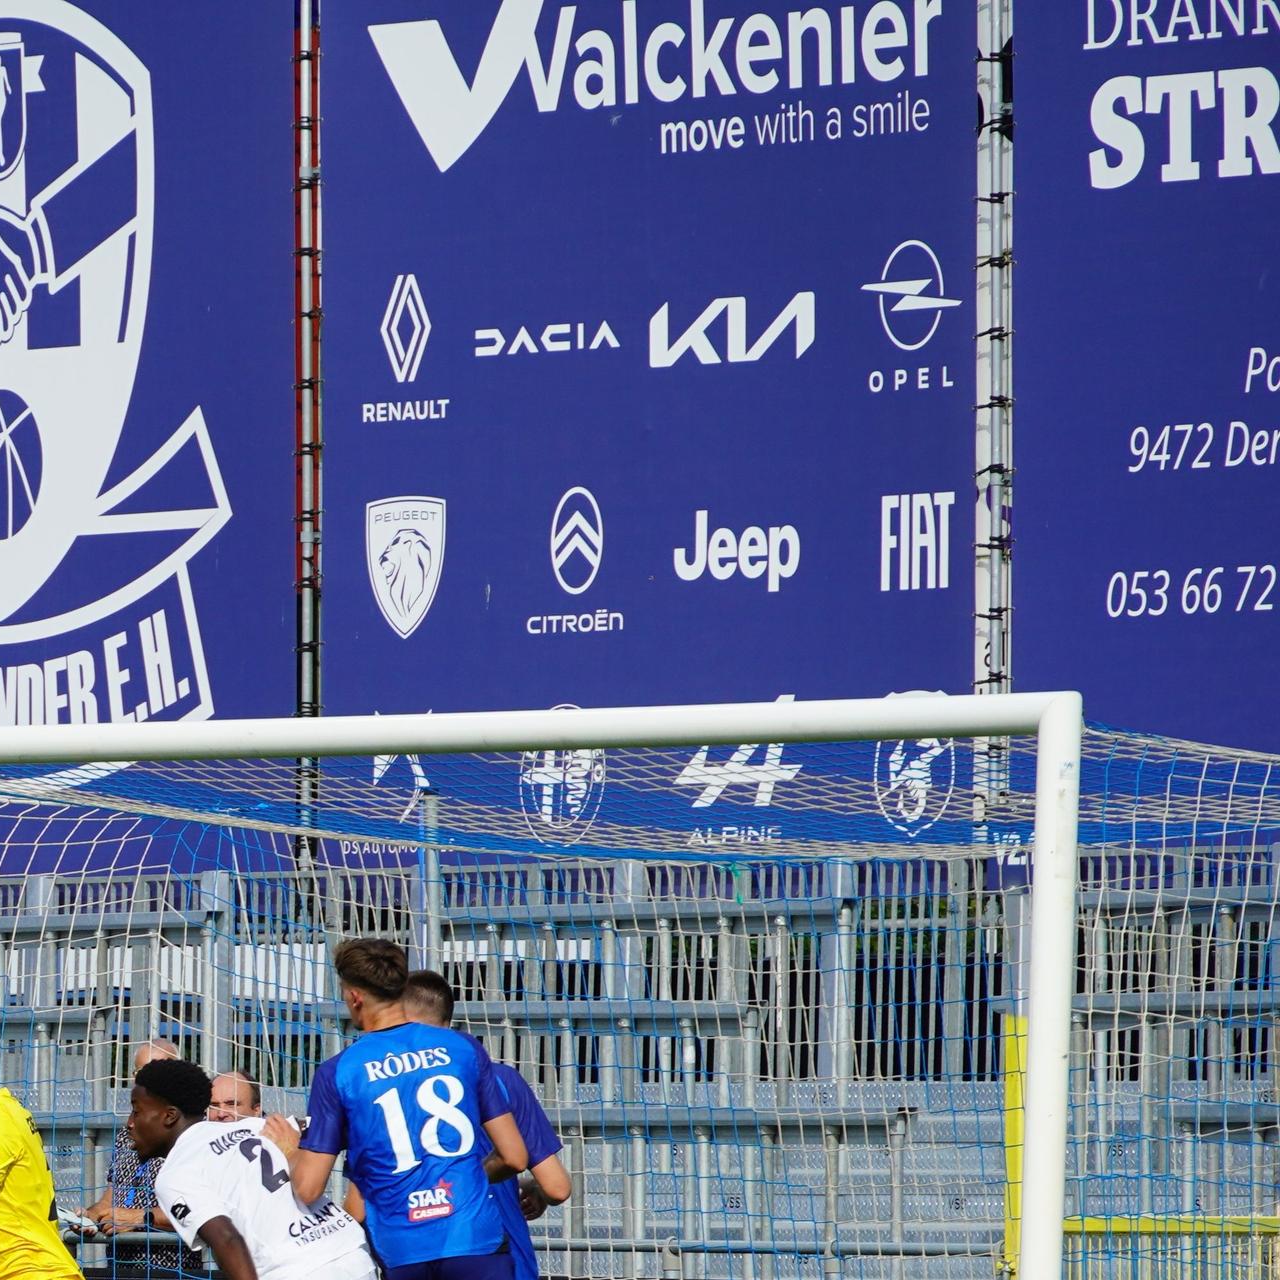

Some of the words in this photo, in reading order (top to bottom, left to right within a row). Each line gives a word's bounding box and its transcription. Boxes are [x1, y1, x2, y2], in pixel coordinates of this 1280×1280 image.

[527, 0, 941, 112] Valckenier
[660, 116, 745, 154] move
[754, 101, 816, 146] with
[825, 109, 842, 140] a
[852, 91, 930, 137] smile
[474, 320, 621, 357] DACIA
[868, 366, 954, 393] OPEL
[362, 399, 450, 423] RENAULT
[1128, 423, 1214, 473] 9472
[373, 507, 438, 524] PEUGEOT
[674, 509, 801, 593] Jeep
[879, 491, 955, 592] FIAT
[1106, 569, 1171, 618] 053
[1181, 566, 1224, 615] 66
[1235, 564, 1277, 612] 72
[364, 1047, 451, 1082] RÔDES
[373, 1074, 475, 1175] 18
[239, 1138, 290, 1193] 2
[407, 1187, 450, 1209] STAR
[412, 1206, 450, 1220] CASINO
[288, 1202, 342, 1238] CALANT
